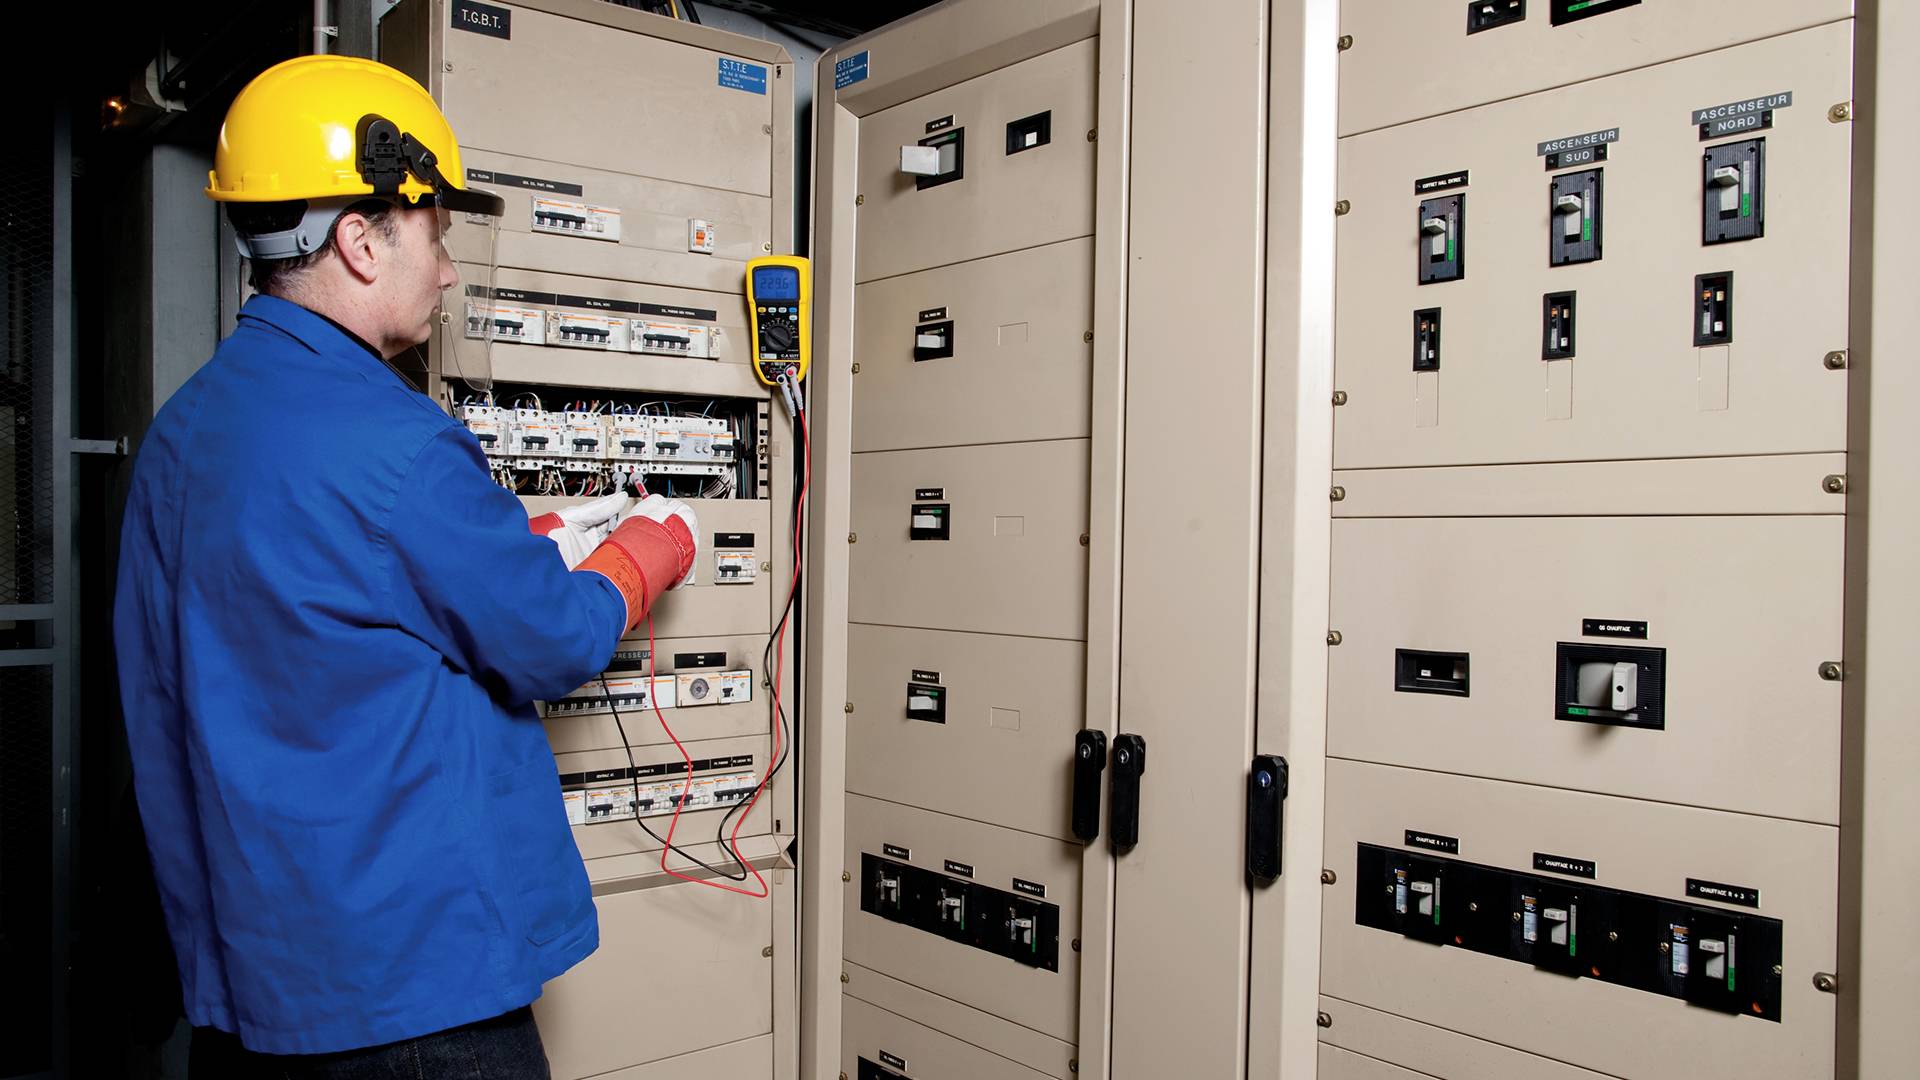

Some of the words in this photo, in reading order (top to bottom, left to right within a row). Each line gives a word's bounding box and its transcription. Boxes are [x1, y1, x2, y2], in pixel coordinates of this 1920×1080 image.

[461, 8, 501, 29] T.G.B.T.
[1699, 94, 1787, 121] ASCENSEUR
[1717, 116, 1756, 131] NORD
[1544, 130, 1616, 152] ASCENSEUR
[1565, 150, 1590, 162] SUD
[1415, 836, 1436, 845] CHAUFFAGE
[1545, 859, 1569, 869] CHAUFFAGE
[1699, 886, 1727, 896] CHAUFFAGE
